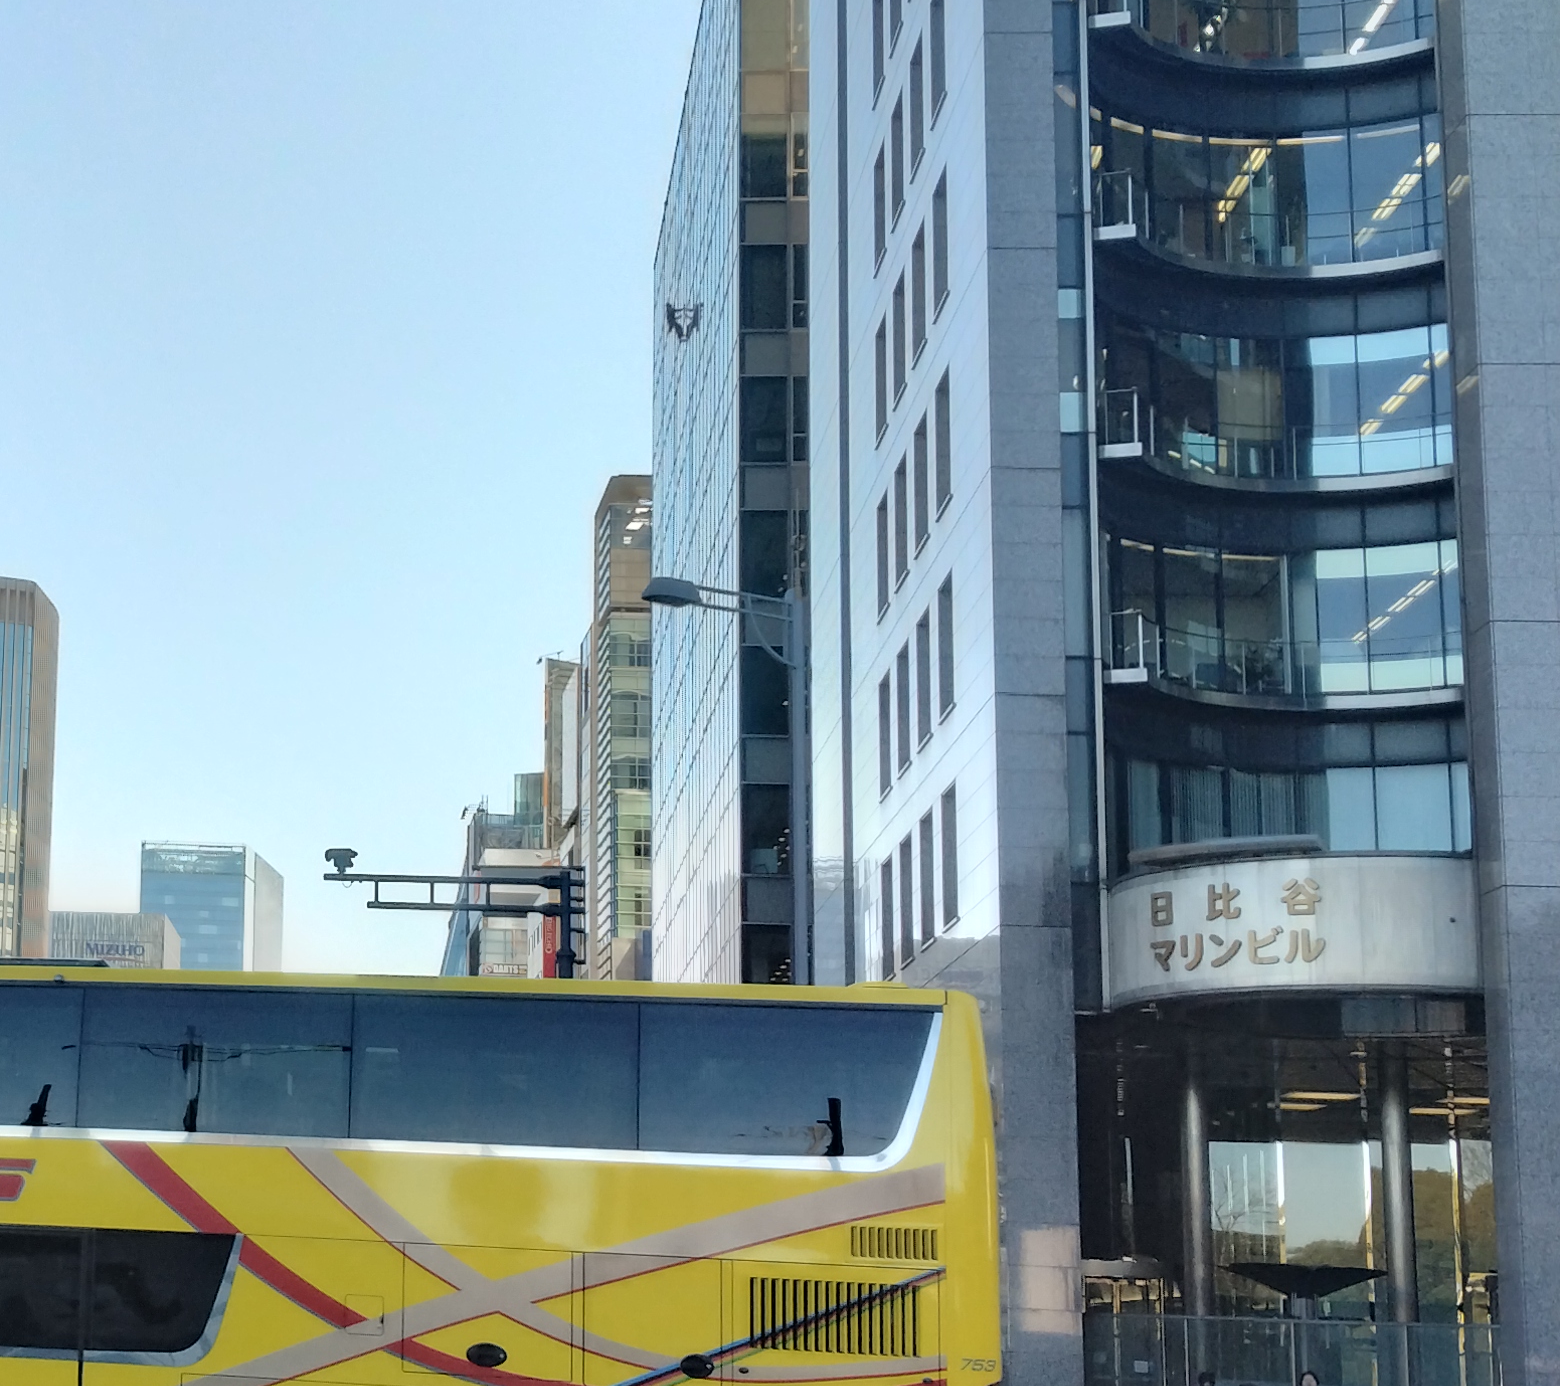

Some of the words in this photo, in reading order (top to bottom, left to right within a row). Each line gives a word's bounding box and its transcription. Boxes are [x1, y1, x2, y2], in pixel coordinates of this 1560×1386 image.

[1151, 878, 1321, 927] 日比谷
[85, 942, 145, 956] MIZUHO
[1150, 926, 1326, 972] マリンビル
[493, 964, 519, 974] DARTS
[961, 1358, 997, 1372] 753
